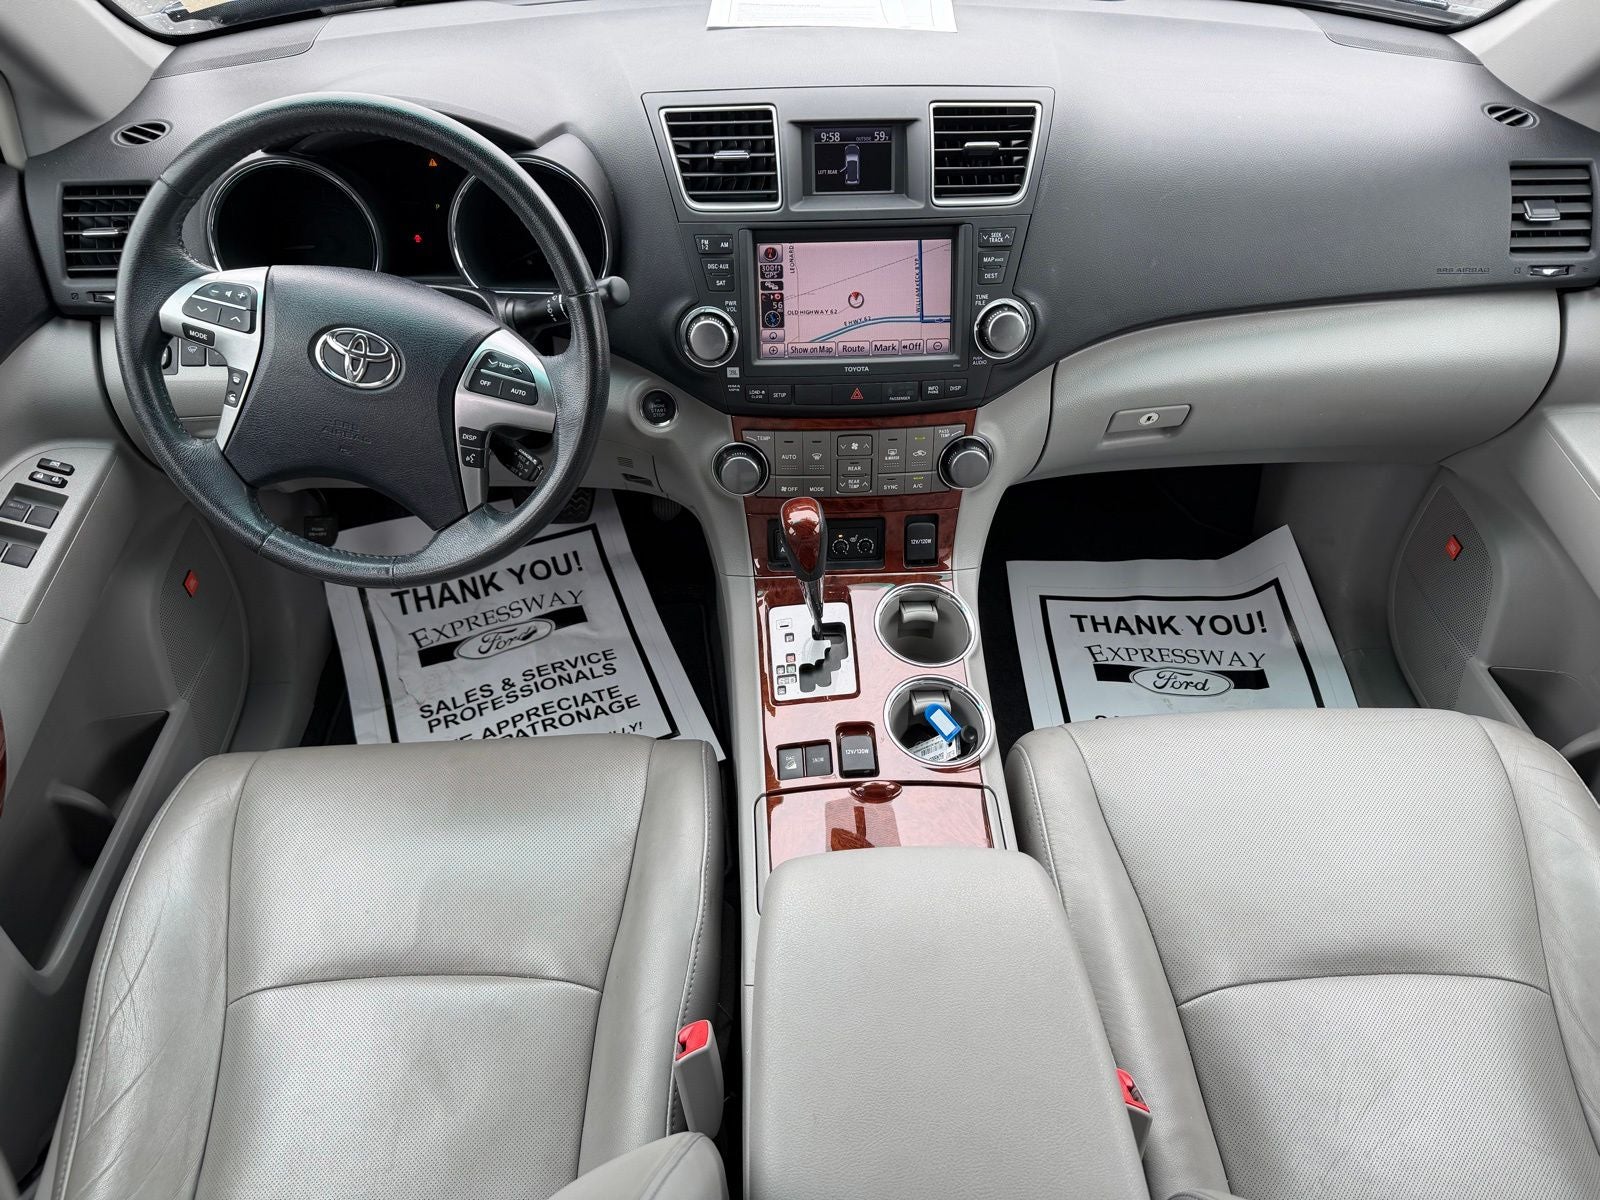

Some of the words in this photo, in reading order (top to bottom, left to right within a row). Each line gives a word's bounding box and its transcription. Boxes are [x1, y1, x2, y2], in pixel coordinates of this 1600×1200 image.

[821, 132, 840, 142] 9:58
[772, 301, 783, 309] 56
[848, 318, 863, 326] HWY
[189, 329, 208, 341] MODE
[790, 345, 809, 354] Show
[818, 345, 834, 355] Map
[842, 344, 865, 353] Route
[874, 343, 897, 352] Mark
[908, 343, 921, 351] Off
[498, 361, 512, 369] TEMP
[480, 379, 492, 387] OFF
[510, 387, 527, 396] AUTO
[462, 433, 477, 441] DISP
[390, 571, 505, 616] THANK
[507, 550, 584, 585] YOU!
[1069, 614, 1182, 636] THANK
[1185, 610, 1268, 636] YOU!
[478, 625, 538, 655] Ford
[419, 683, 494, 719] SALES
[501, 677, 517, 692] &
[522, 648, 617, 683] SERVICE
[1152, 670, 1211, 692] Ford
[427, 663, 617, 733] PROFESSIONALS
[481, 685, 623, 740] APPRECIATE
